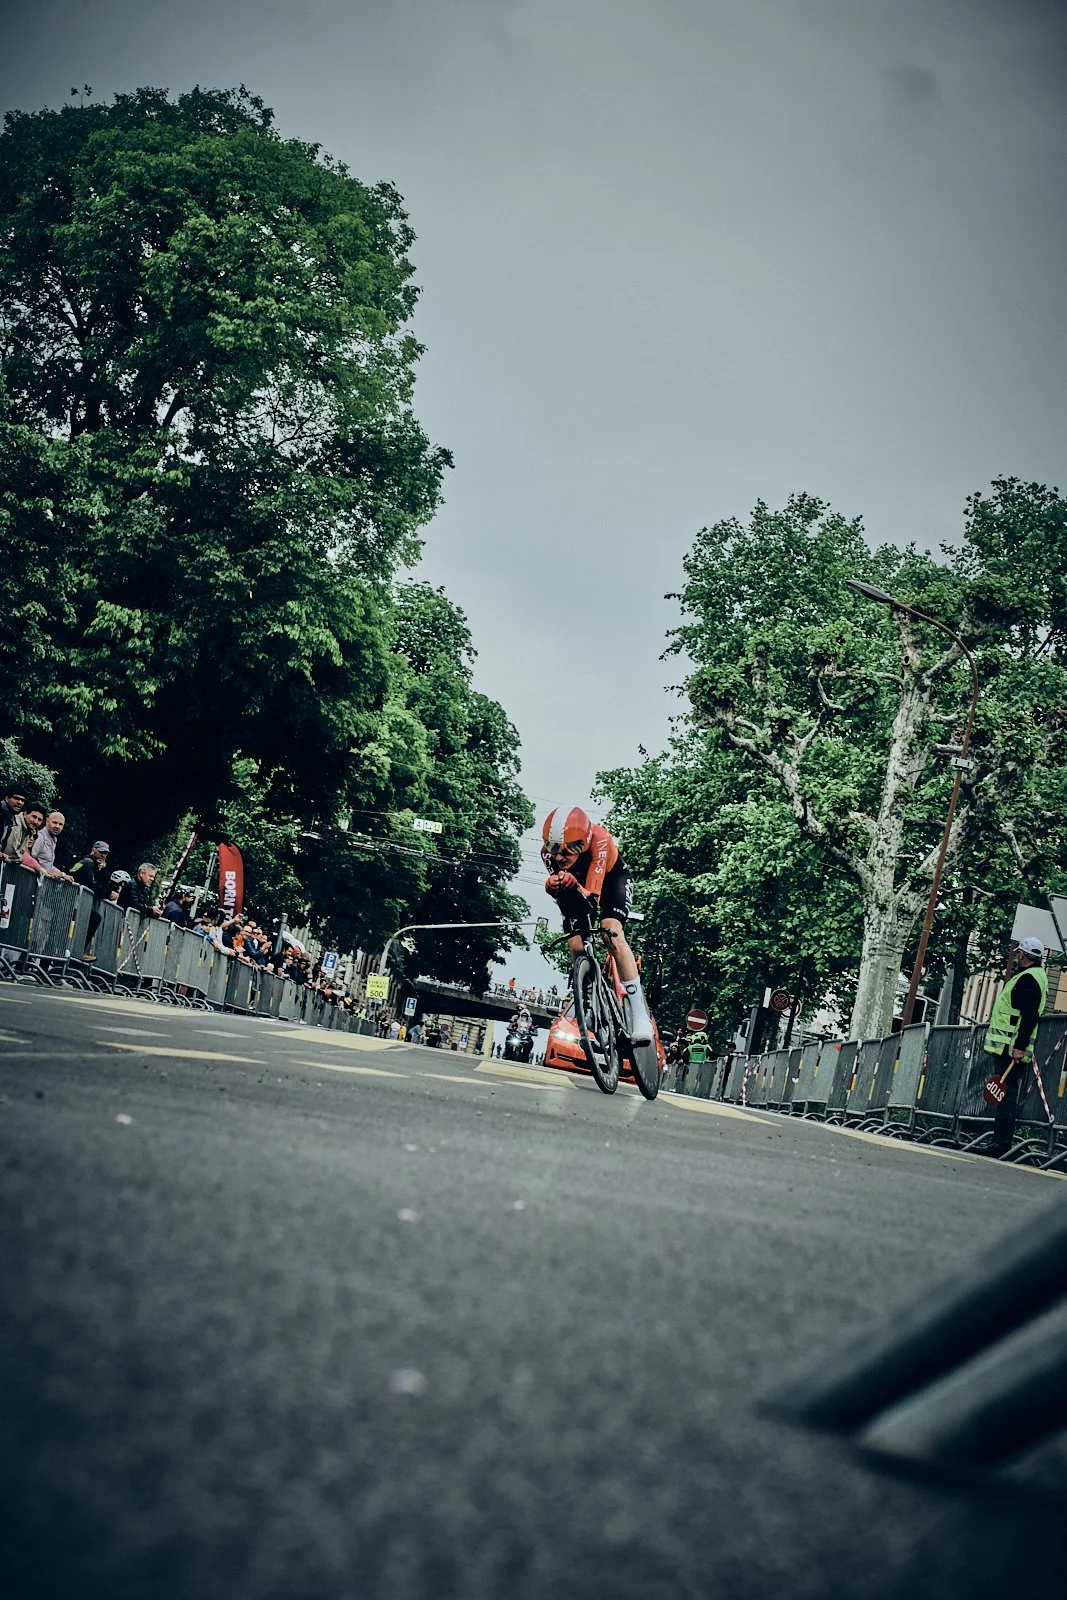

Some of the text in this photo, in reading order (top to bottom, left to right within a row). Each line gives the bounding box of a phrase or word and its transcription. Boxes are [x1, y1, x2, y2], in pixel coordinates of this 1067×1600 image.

[542, 852, 555, 875] EOS
[595, 838, 608, 875] INEOS
[223, 870, 237, 907] BORN
[370, 990, 384, 998] 500
[986, 1081, 1005, 1102] STOP
